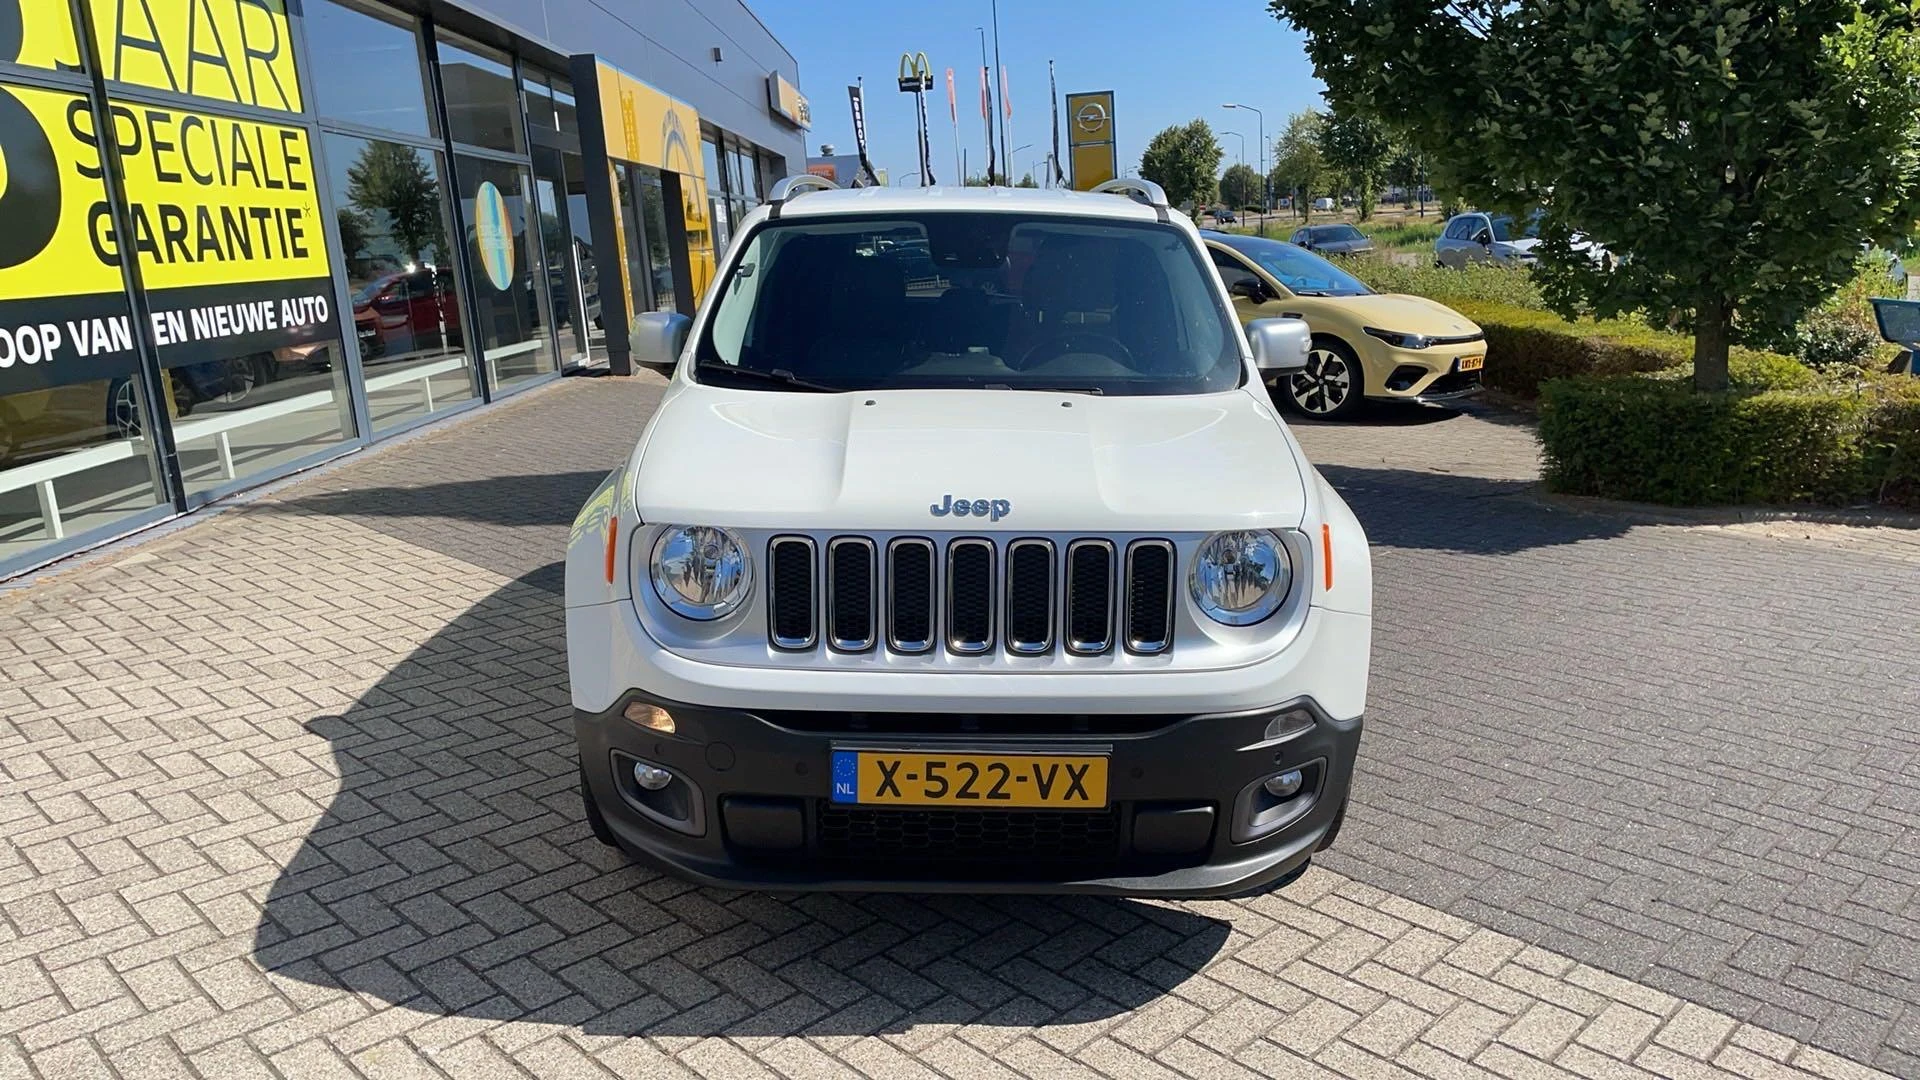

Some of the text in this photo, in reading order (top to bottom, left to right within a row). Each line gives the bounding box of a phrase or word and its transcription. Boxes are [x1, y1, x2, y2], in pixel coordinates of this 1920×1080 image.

[55, 0, 292, 112] AAR
[67, 99, 307, 191] SPECIALE
[66, 315, 133, 357] VAN
[151, 308, 188, 346] EN
[191, 301, 277, 341] NIEUWE
[281, 295, 329, 329] AUTO
[930, 495, 1011, 522] Jeep
[836, 760, 1090, 801] NL X-522-VX
